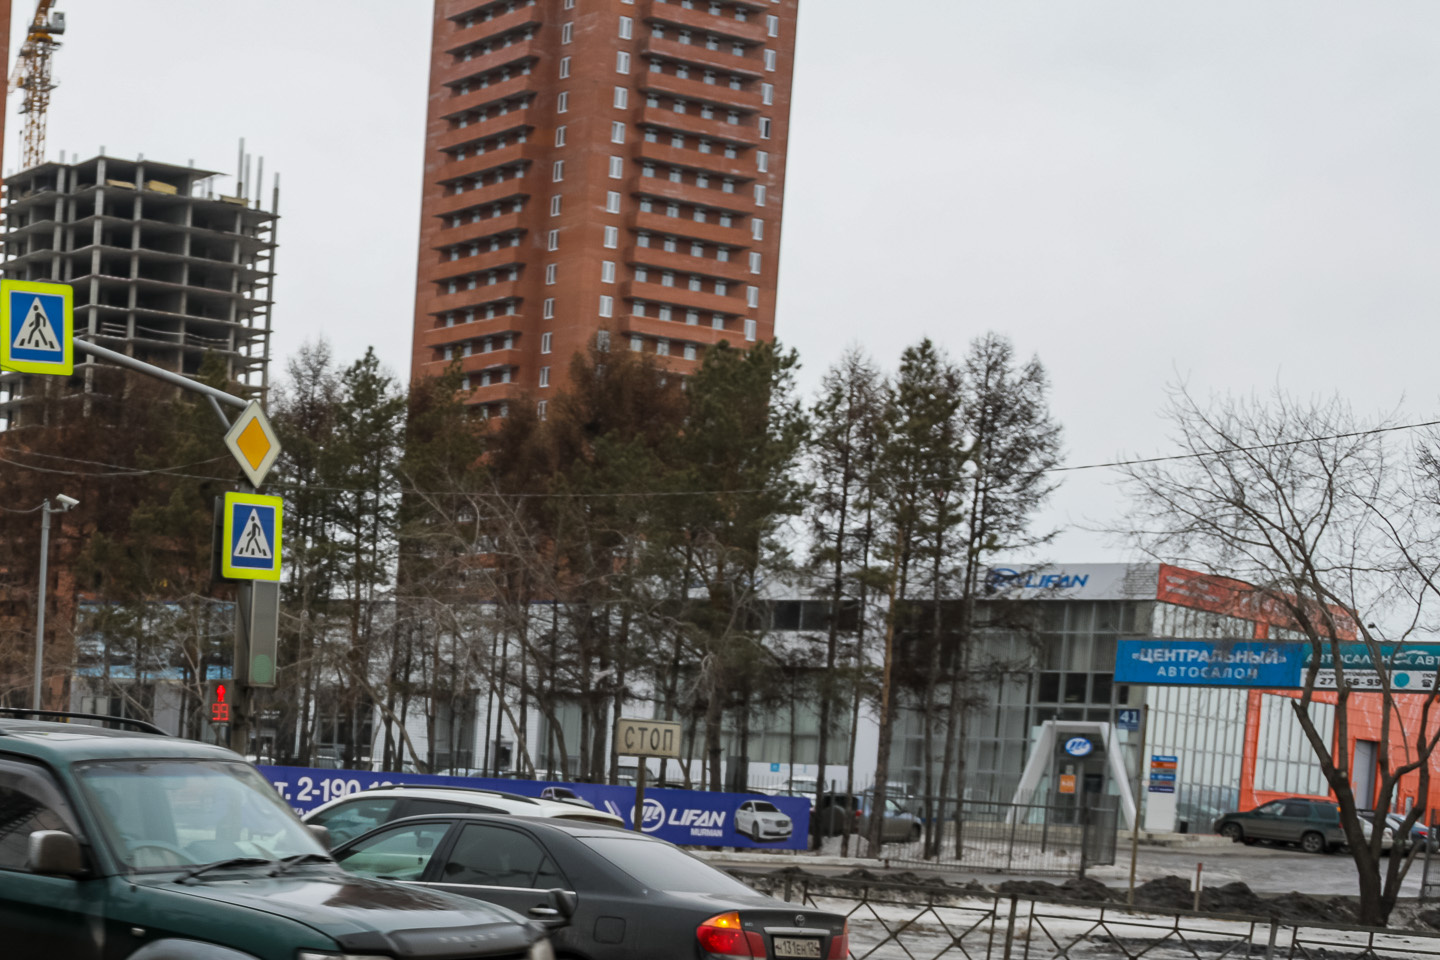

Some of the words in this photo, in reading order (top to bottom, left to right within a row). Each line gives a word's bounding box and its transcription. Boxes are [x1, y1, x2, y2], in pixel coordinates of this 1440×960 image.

[1025, 574, 1090, 588] LIFAN
[212, 703, 229, 721] 99
[1120, 711, 1138, 723] 41
[625, 726, 674, 751] СТОП
[668, 808, 726, 827] LIFAN
